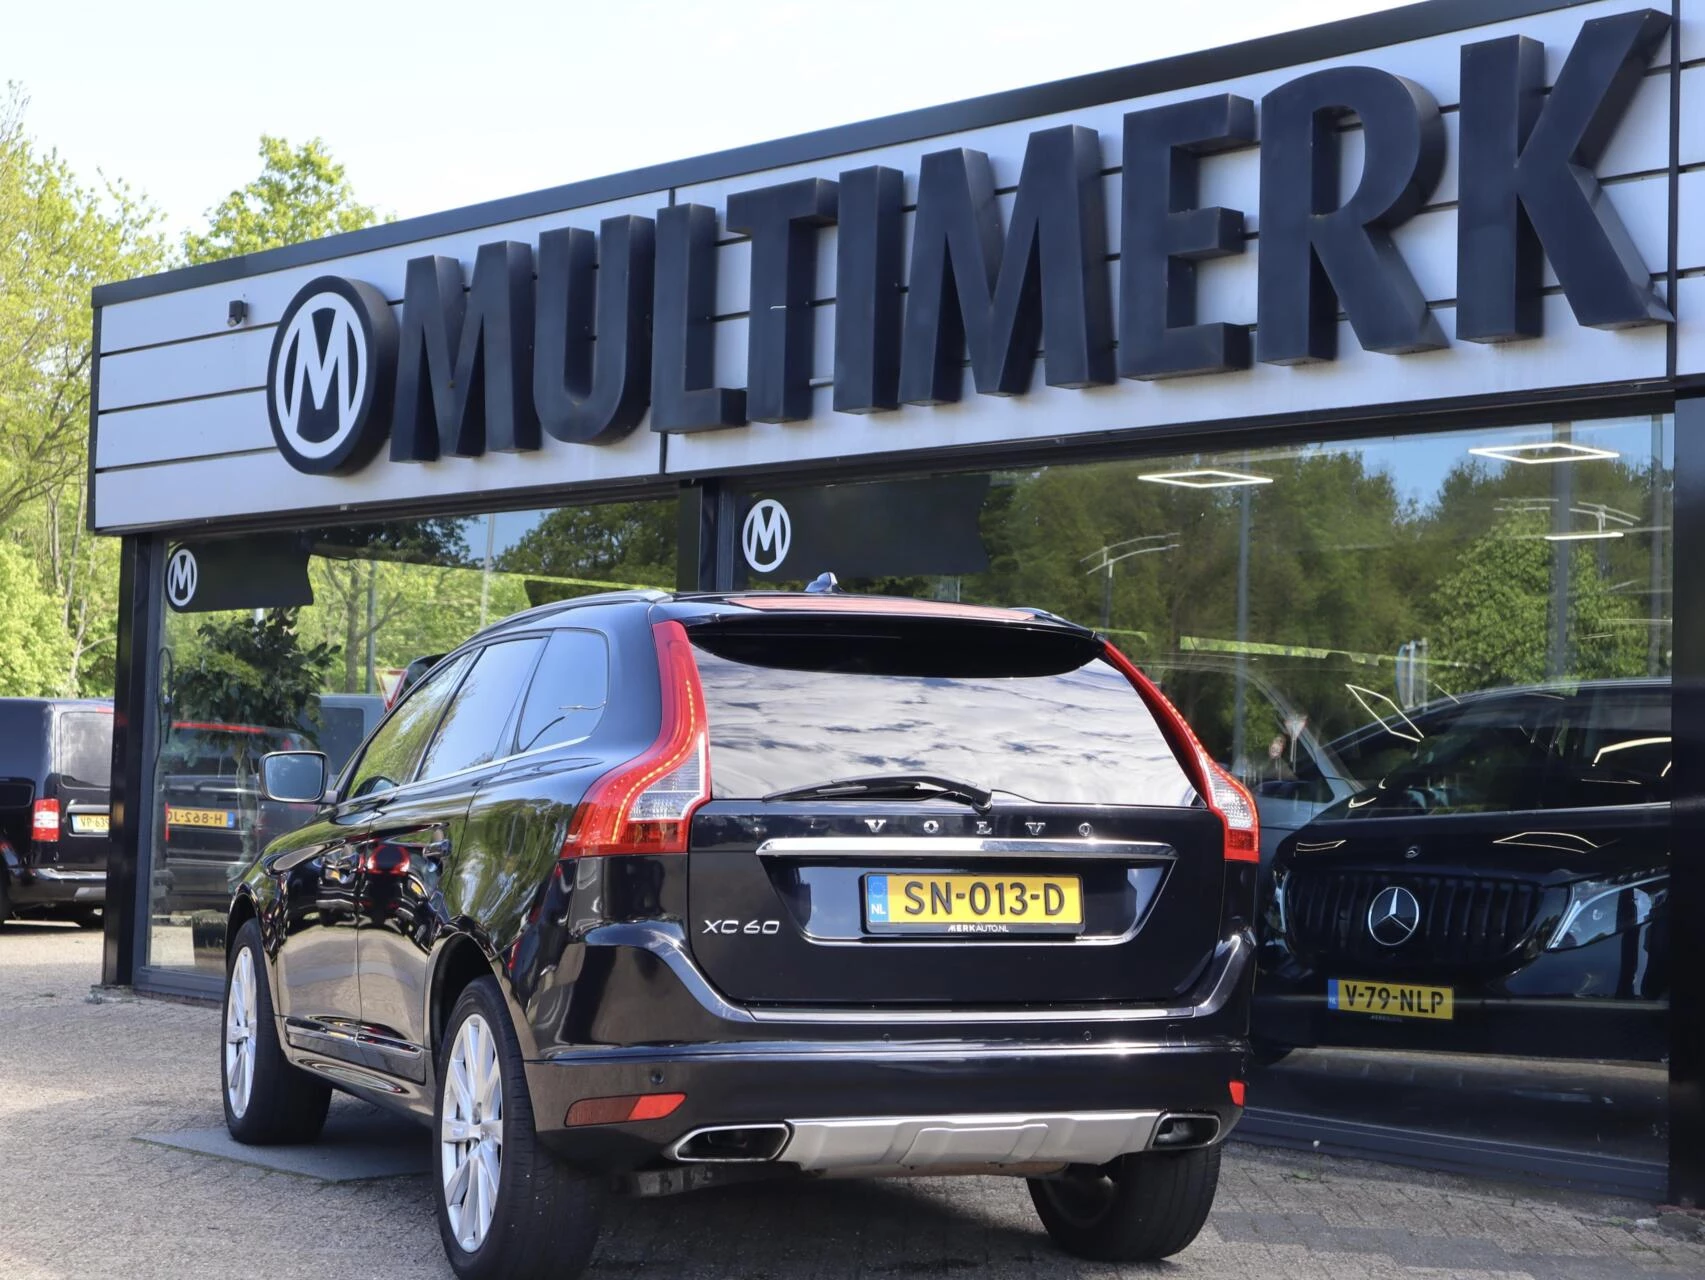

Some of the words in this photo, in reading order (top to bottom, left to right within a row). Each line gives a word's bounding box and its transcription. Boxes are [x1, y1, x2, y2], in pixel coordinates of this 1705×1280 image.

[391, 8, 1673, 462] MULTIMERK
[275, 291, 368, 459] M
[742, 499, 792, 573] M
[167, 549, 198, 607] M
[864, 819, 1093, 836] VOLVO
[871, 903, 887, 916] NL
[904, 881, 1065, 916] SN-013-D
[948, 924, 1010, 933] MERKAUTO.NL
[1344, 984, 1444, 1014] V-79-NLP
